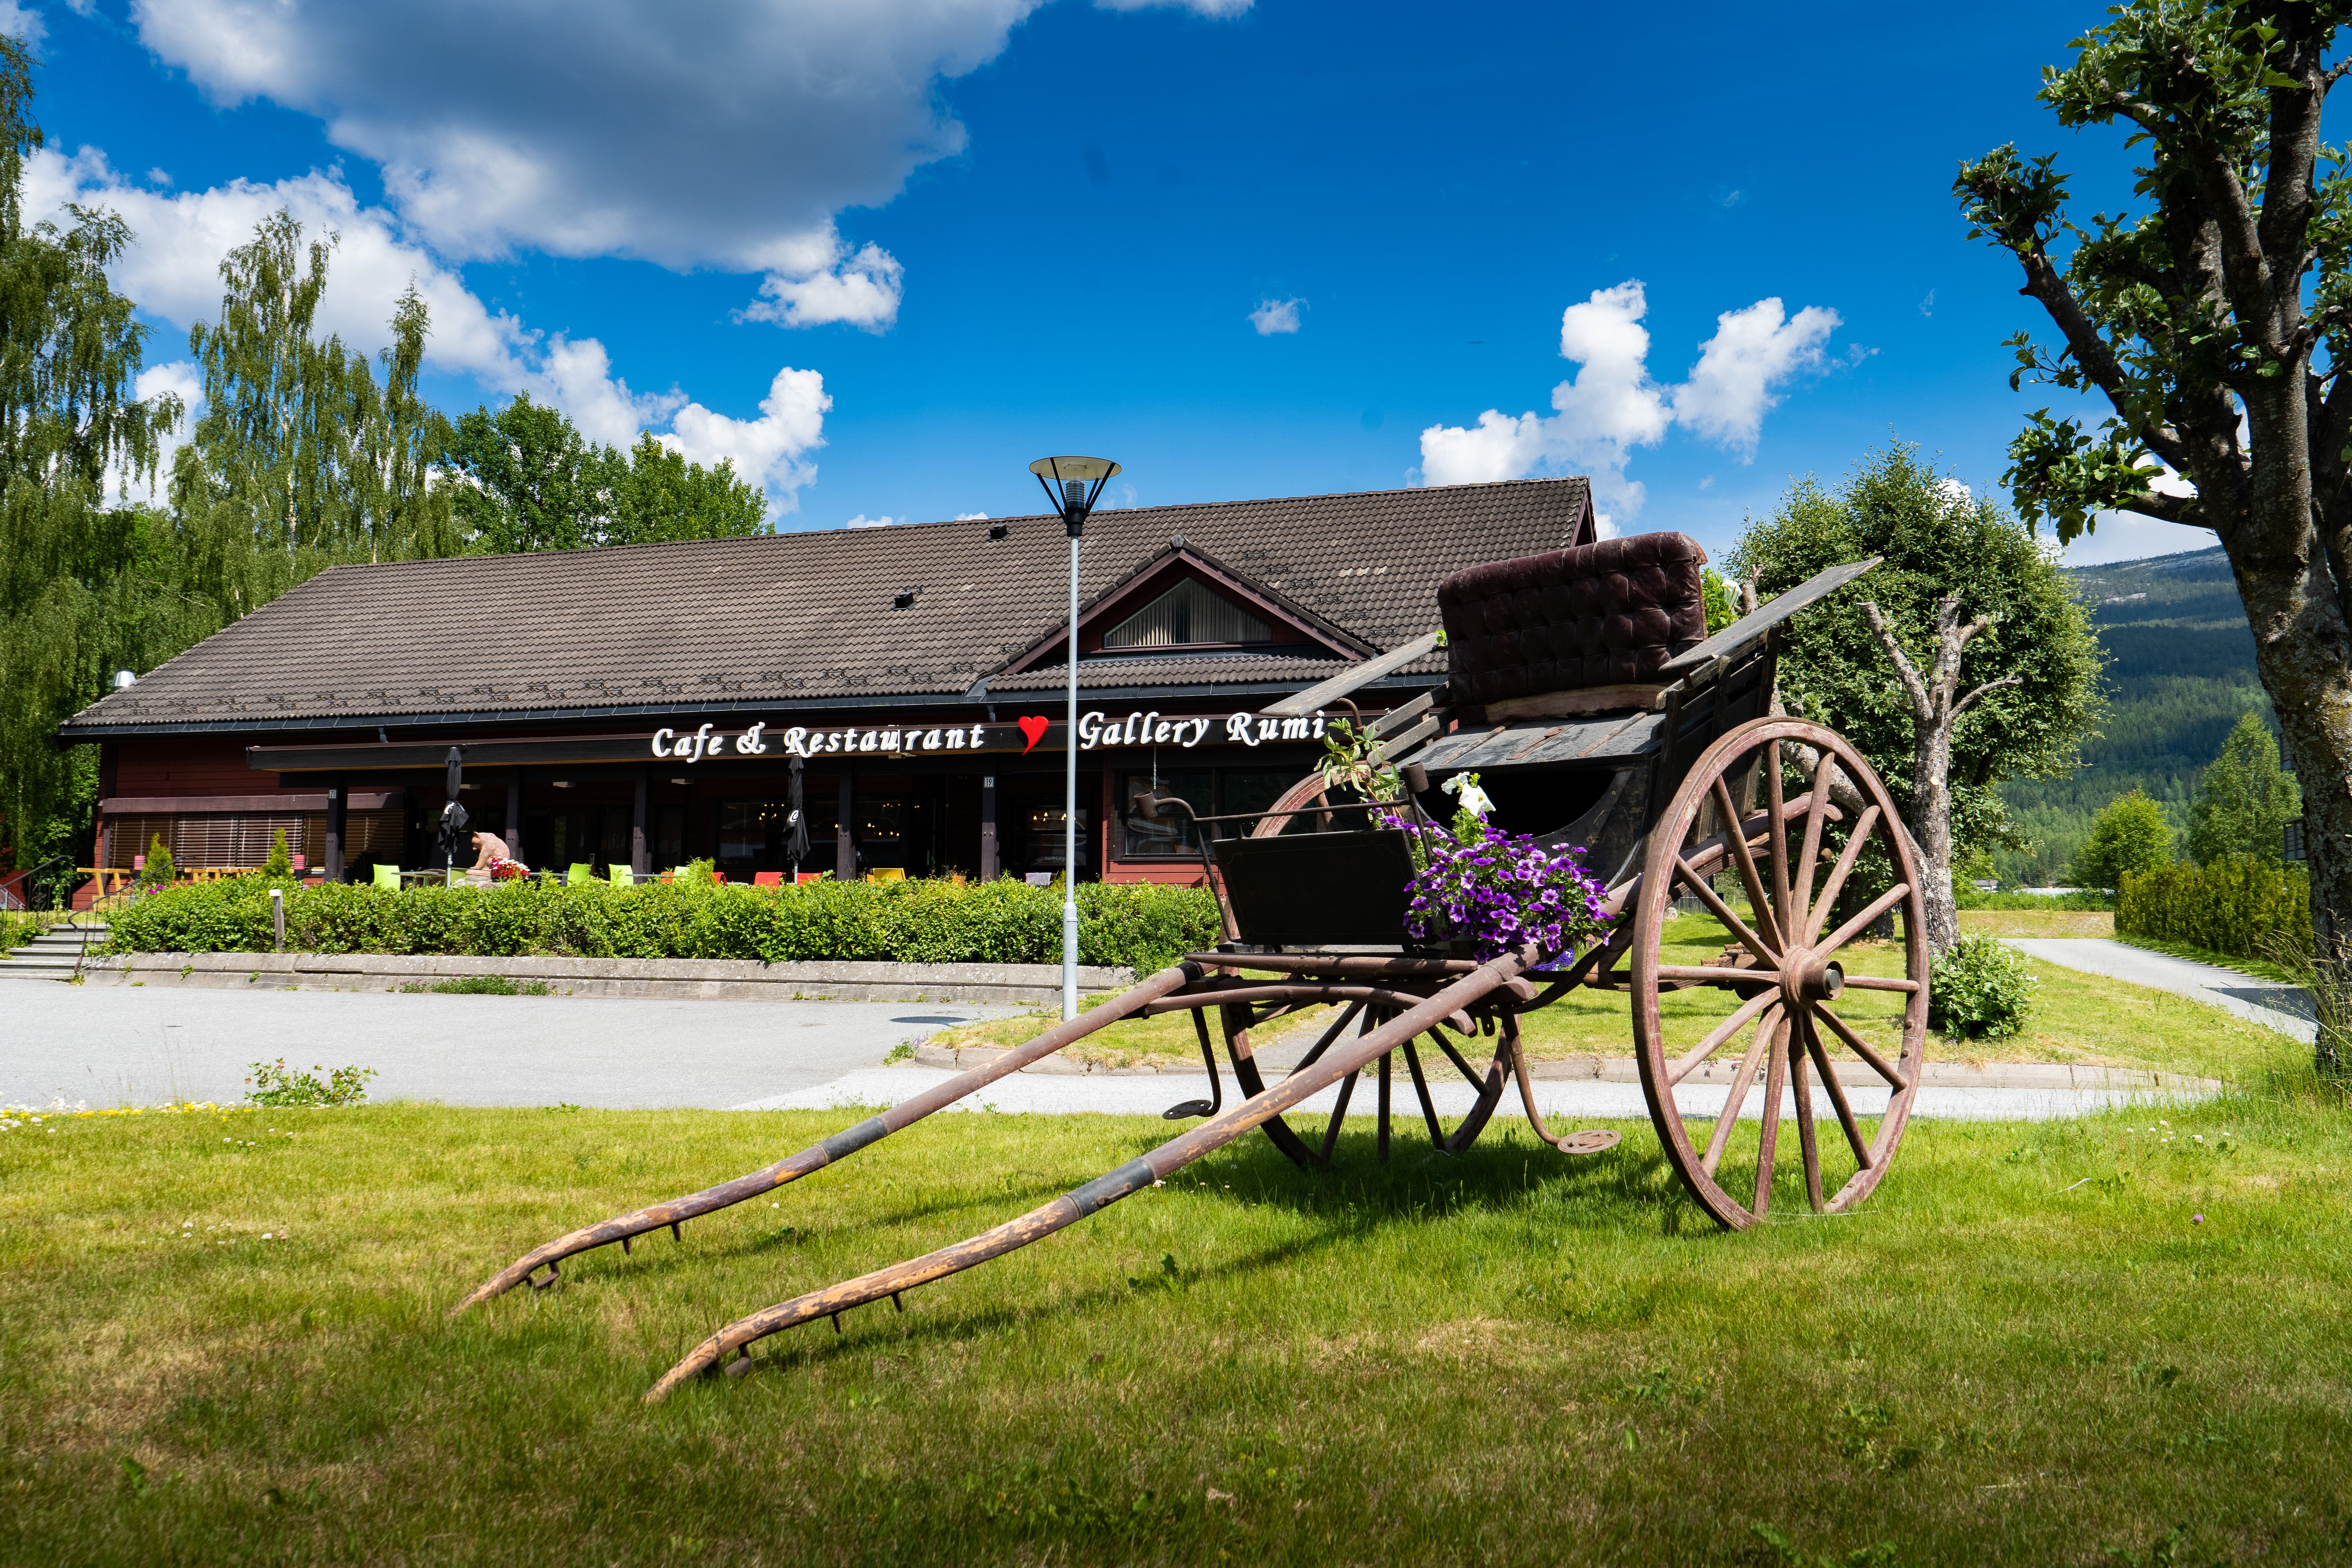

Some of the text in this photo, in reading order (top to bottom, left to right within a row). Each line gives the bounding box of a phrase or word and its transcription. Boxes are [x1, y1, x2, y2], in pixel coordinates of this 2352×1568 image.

[652, 710, 1325, 763] Cafe & Restaurant Gallery Rumi
[986, 778, 992, 786] 19
